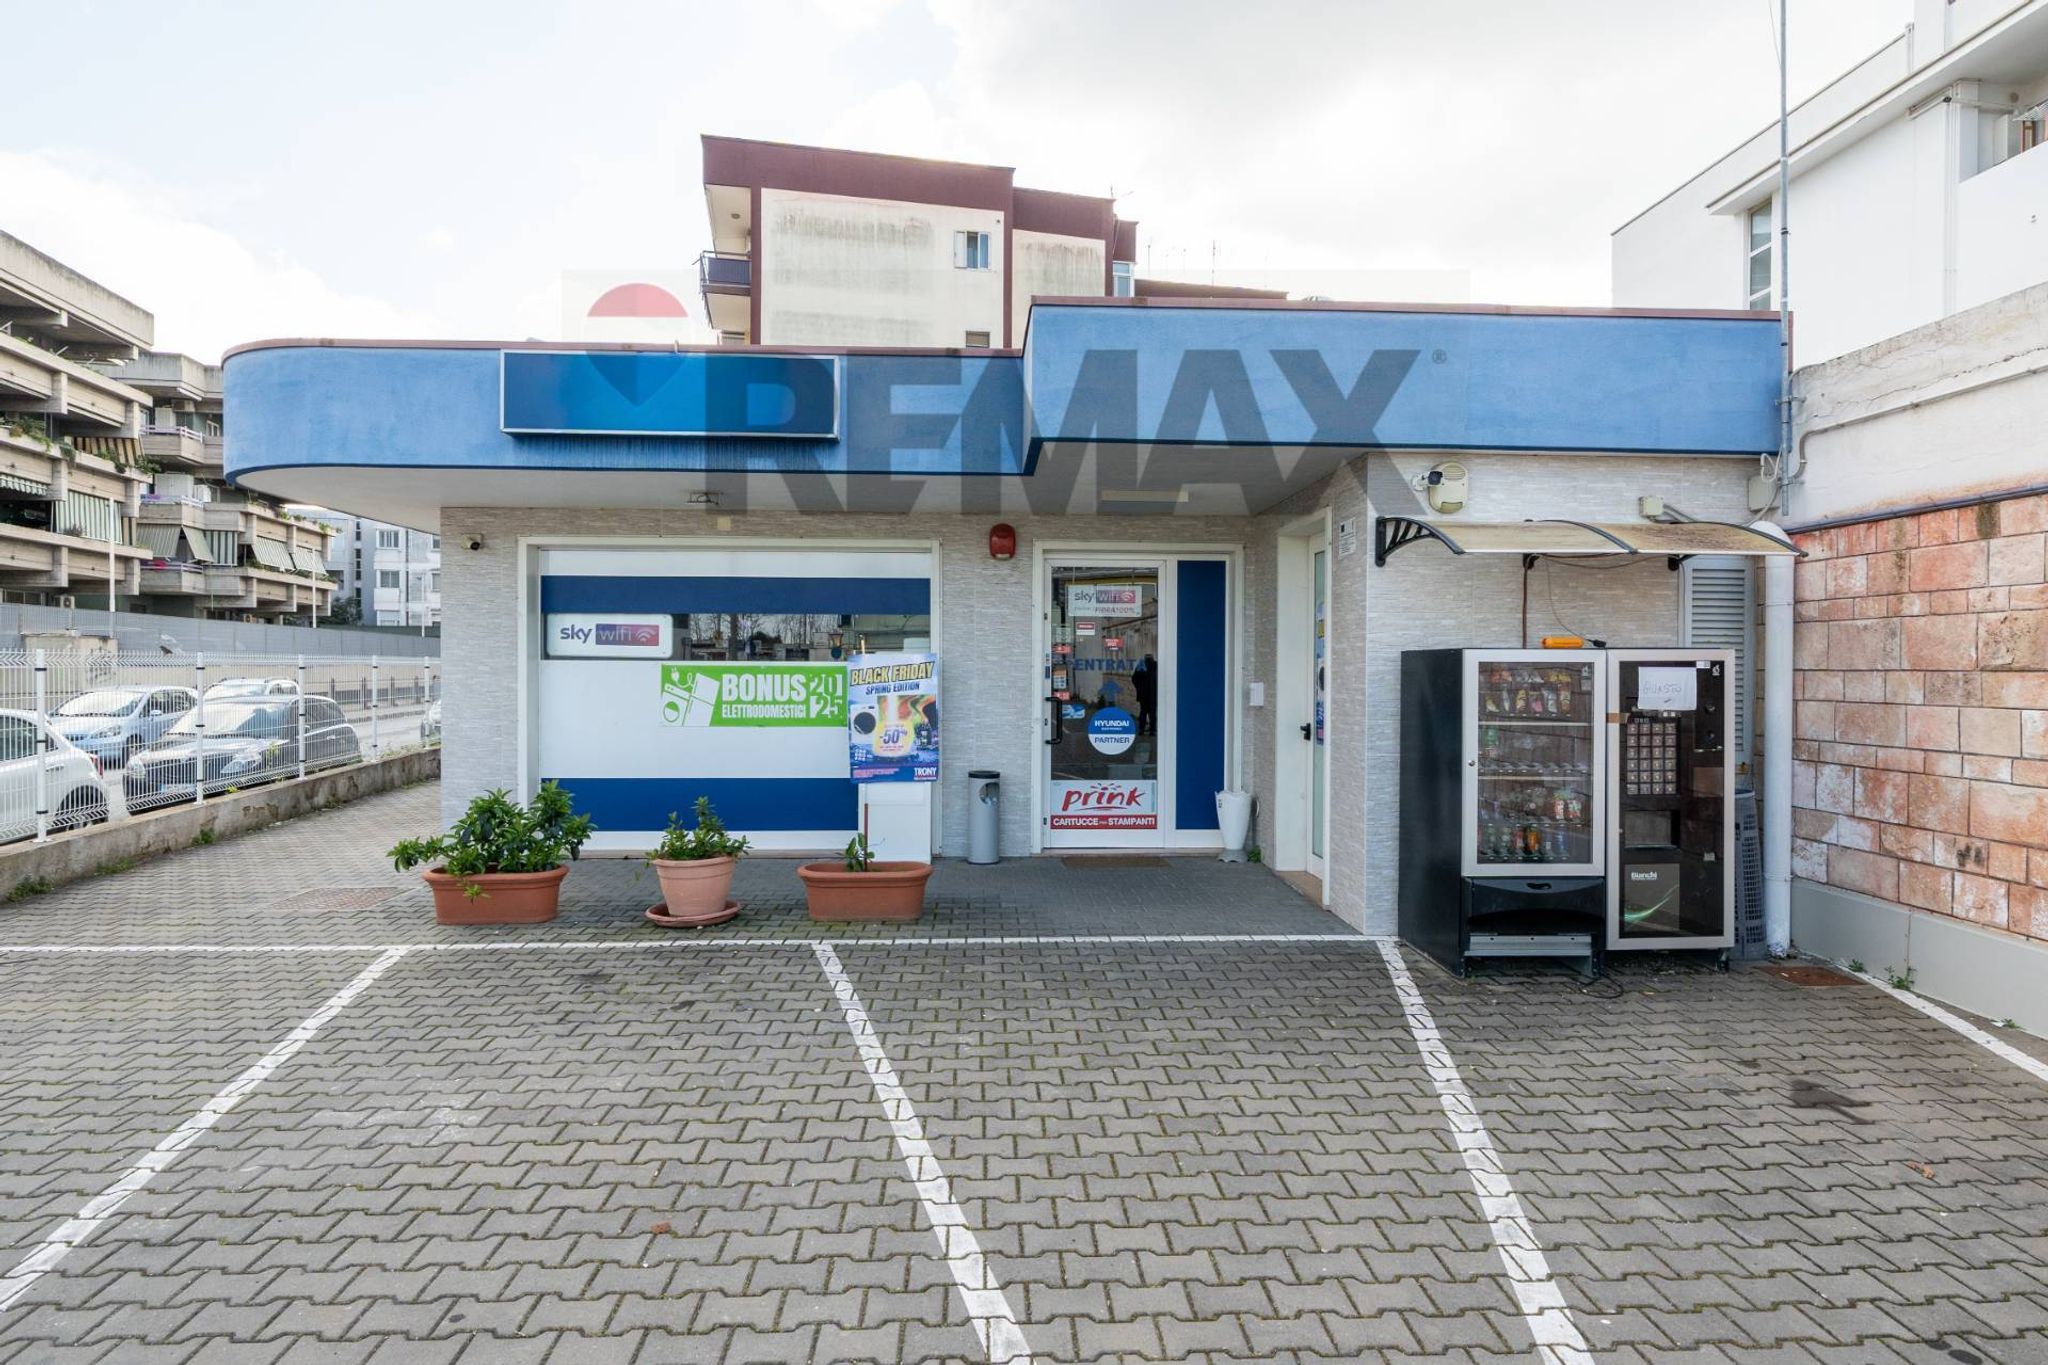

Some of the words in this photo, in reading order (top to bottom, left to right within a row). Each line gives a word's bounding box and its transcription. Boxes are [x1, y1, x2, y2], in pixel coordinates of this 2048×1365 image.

[1074, 590, 1095, 603] sky
[560, 623, 592, 644] sky
[598, 625, 632, 641] wifi
[1076, 658, 1147, 672] ENTRATA
[850, 667, 890, 687] BLACK
[890, 660, 935, 682] FRIDAY
[722, 673, 807, 702] BONUS
[865, 684, 892, 695] SPRING
[893, 682, 920, 692] EDITION
[722, 704, 806, 719] ELETTRODOMESTICI
[914, 767, 937, 776] TRONY
[1061, 786, 1146, 812] prink
[1053, 818, 1099, 826] CARTUCCE
[1108, 817, 1155, 826] STAMPANTI
